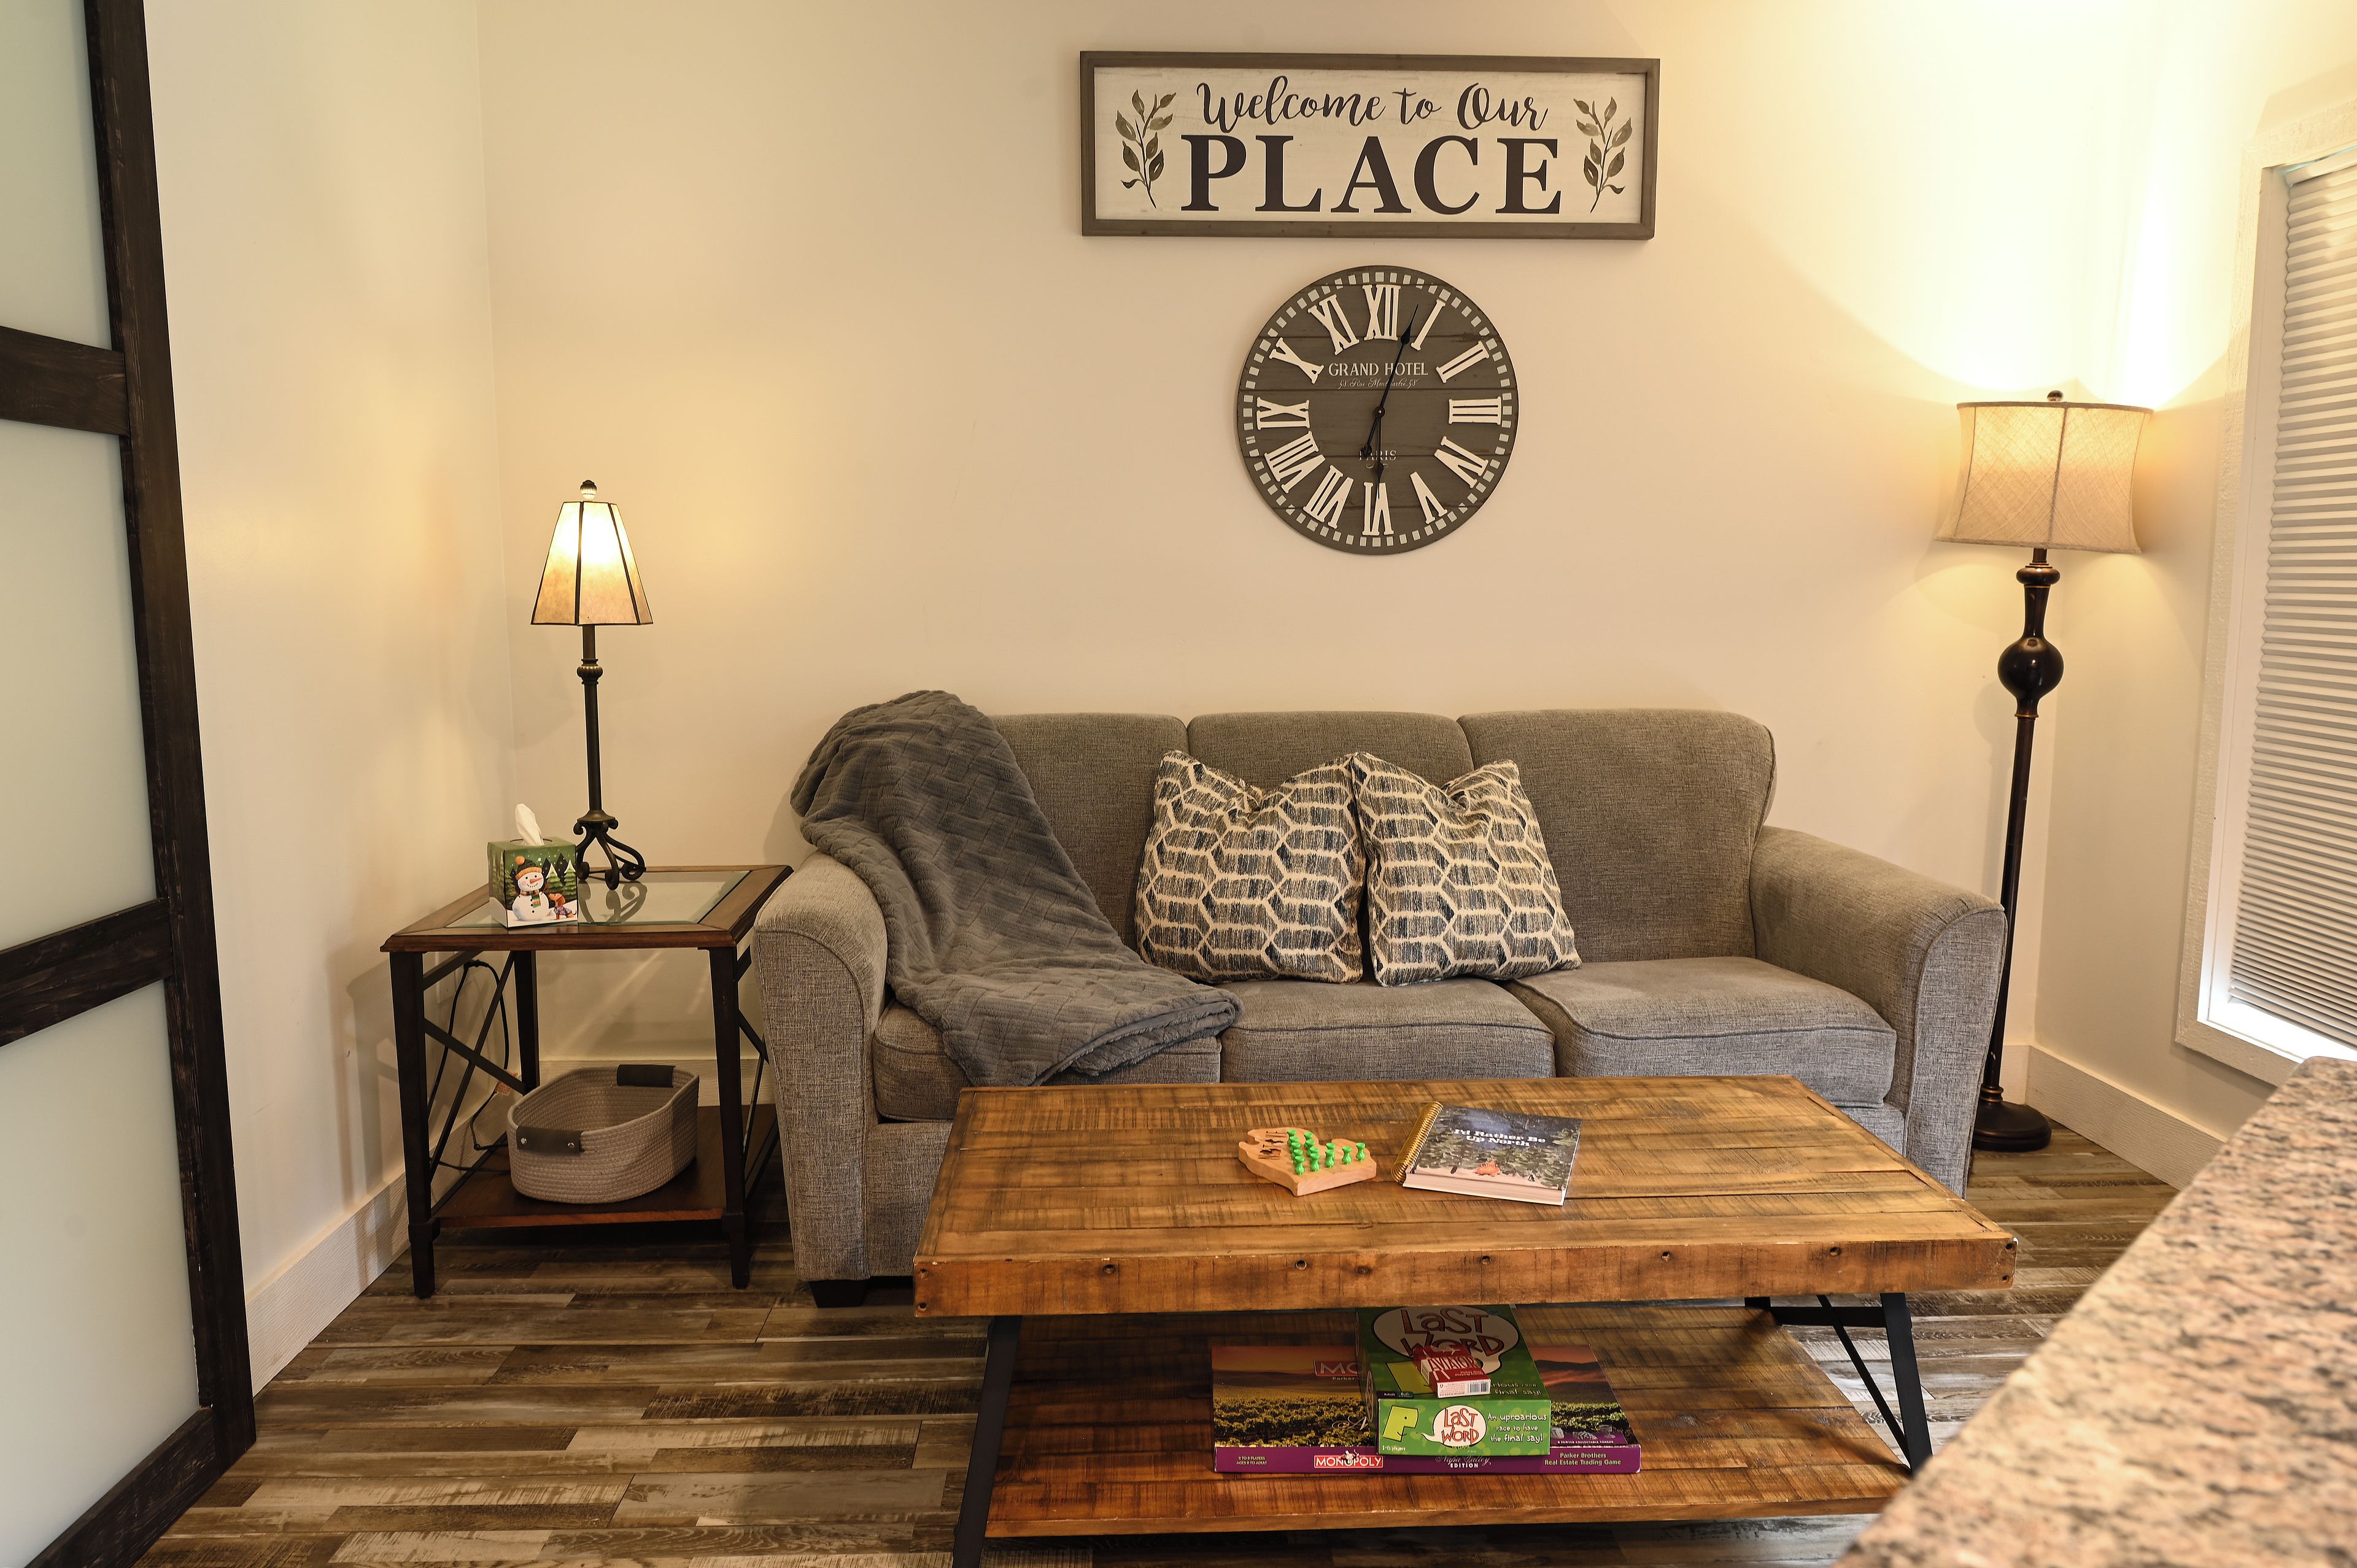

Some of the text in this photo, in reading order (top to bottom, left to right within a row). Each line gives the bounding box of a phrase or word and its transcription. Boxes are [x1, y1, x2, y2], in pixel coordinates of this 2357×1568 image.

[1196, 75, 1549, 133] Welcome to Our
[1180, 134, 1562, 215] PLACE
[1362, 284, 1401, 341] XII
[1307, 294, 1360, 356] XI
[1269, 337, 1325, 384] X
[1328, 362, 1429, 377] GRAND HOTEL
[1436, 341, 1490, 384] II
[1449, 396, 1501, 425] III
[1474, 1130, 1524, 1141] Rather
[1488, 1138, 1530, 1147] North
[1487, 1412, 1547, 1423] An uproarious
[1441, 1427, 1479, 1445] WORD
[1523, 1423, 1539, 1431] have
[1490, 1433, 1501, 1442] the
[1504, 1432, 1524, 1442] final
[1315, 1456, 1382, 1467] MONOPOLY
